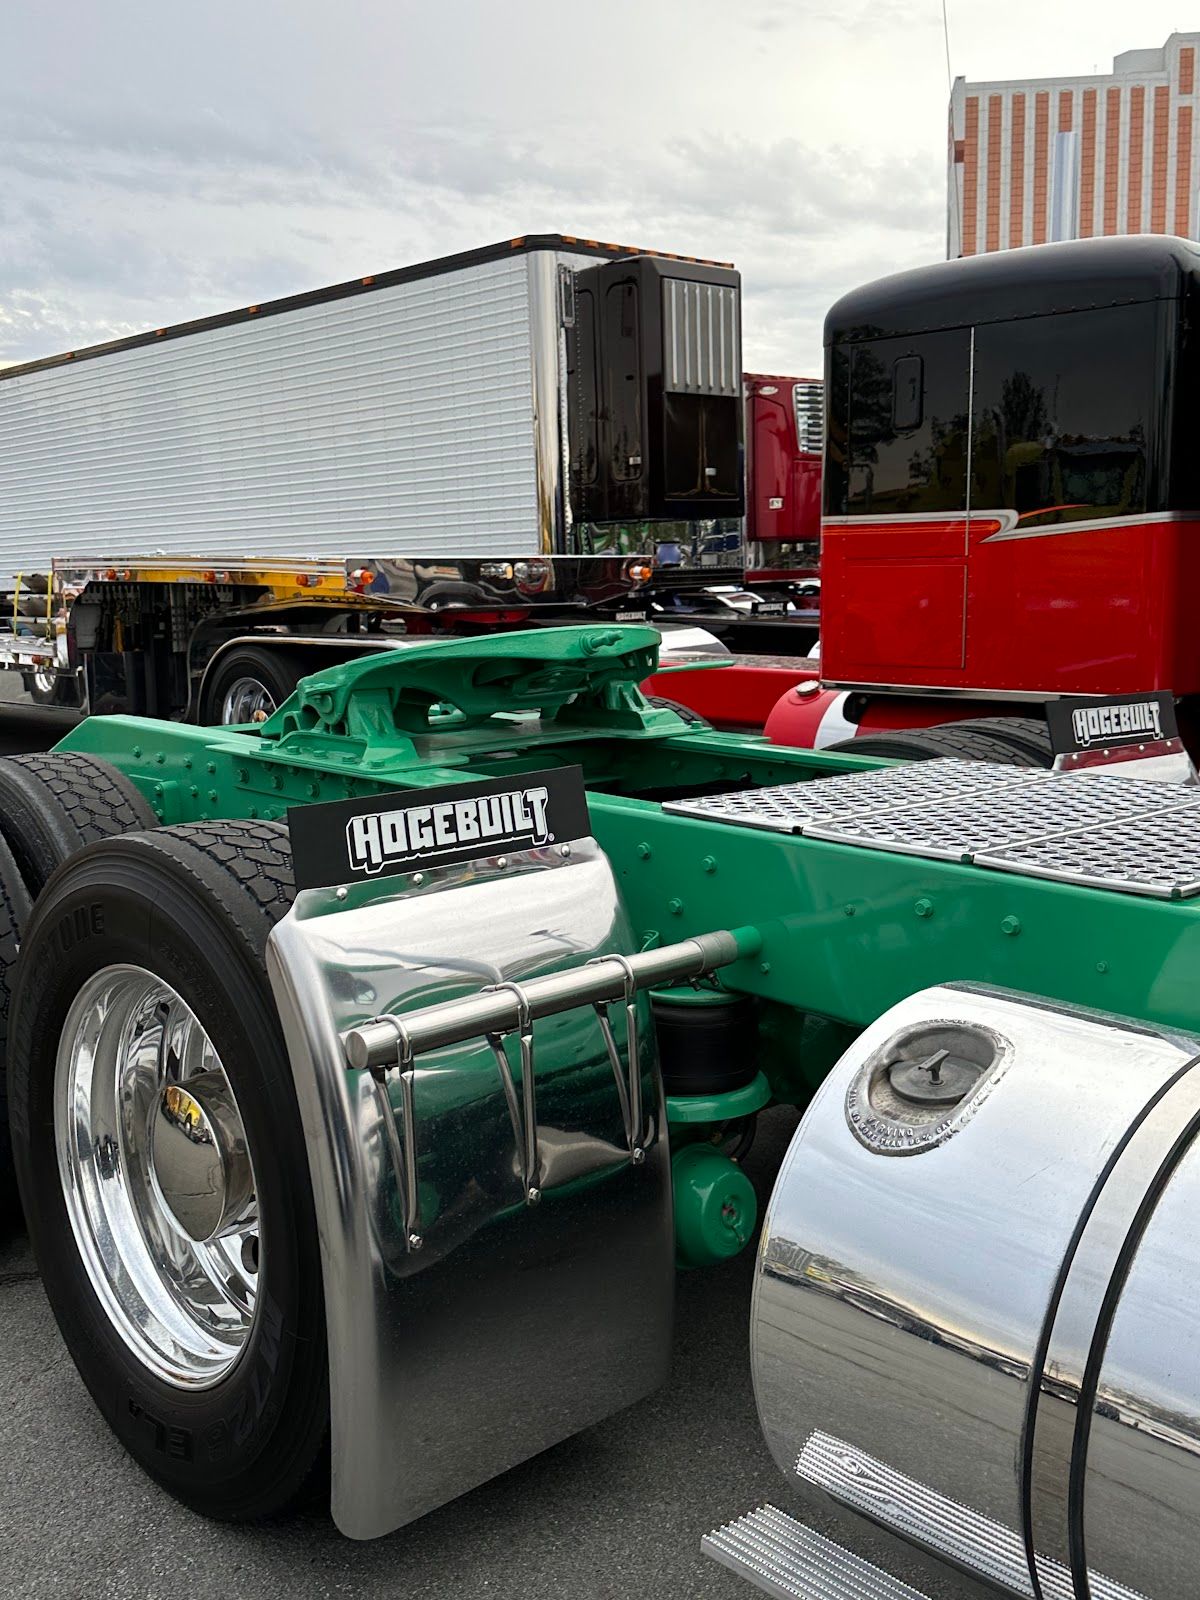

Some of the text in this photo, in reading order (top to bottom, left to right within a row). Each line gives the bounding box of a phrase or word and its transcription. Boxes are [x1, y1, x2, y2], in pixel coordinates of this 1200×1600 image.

[1072, 702, 1160, 746] HOGEBUILT
[347, 787, 548, 873] HOGEBUILT
[867, 1114, 913, 1137] WARNING
[881, 1138, 902, 1147] THAN
